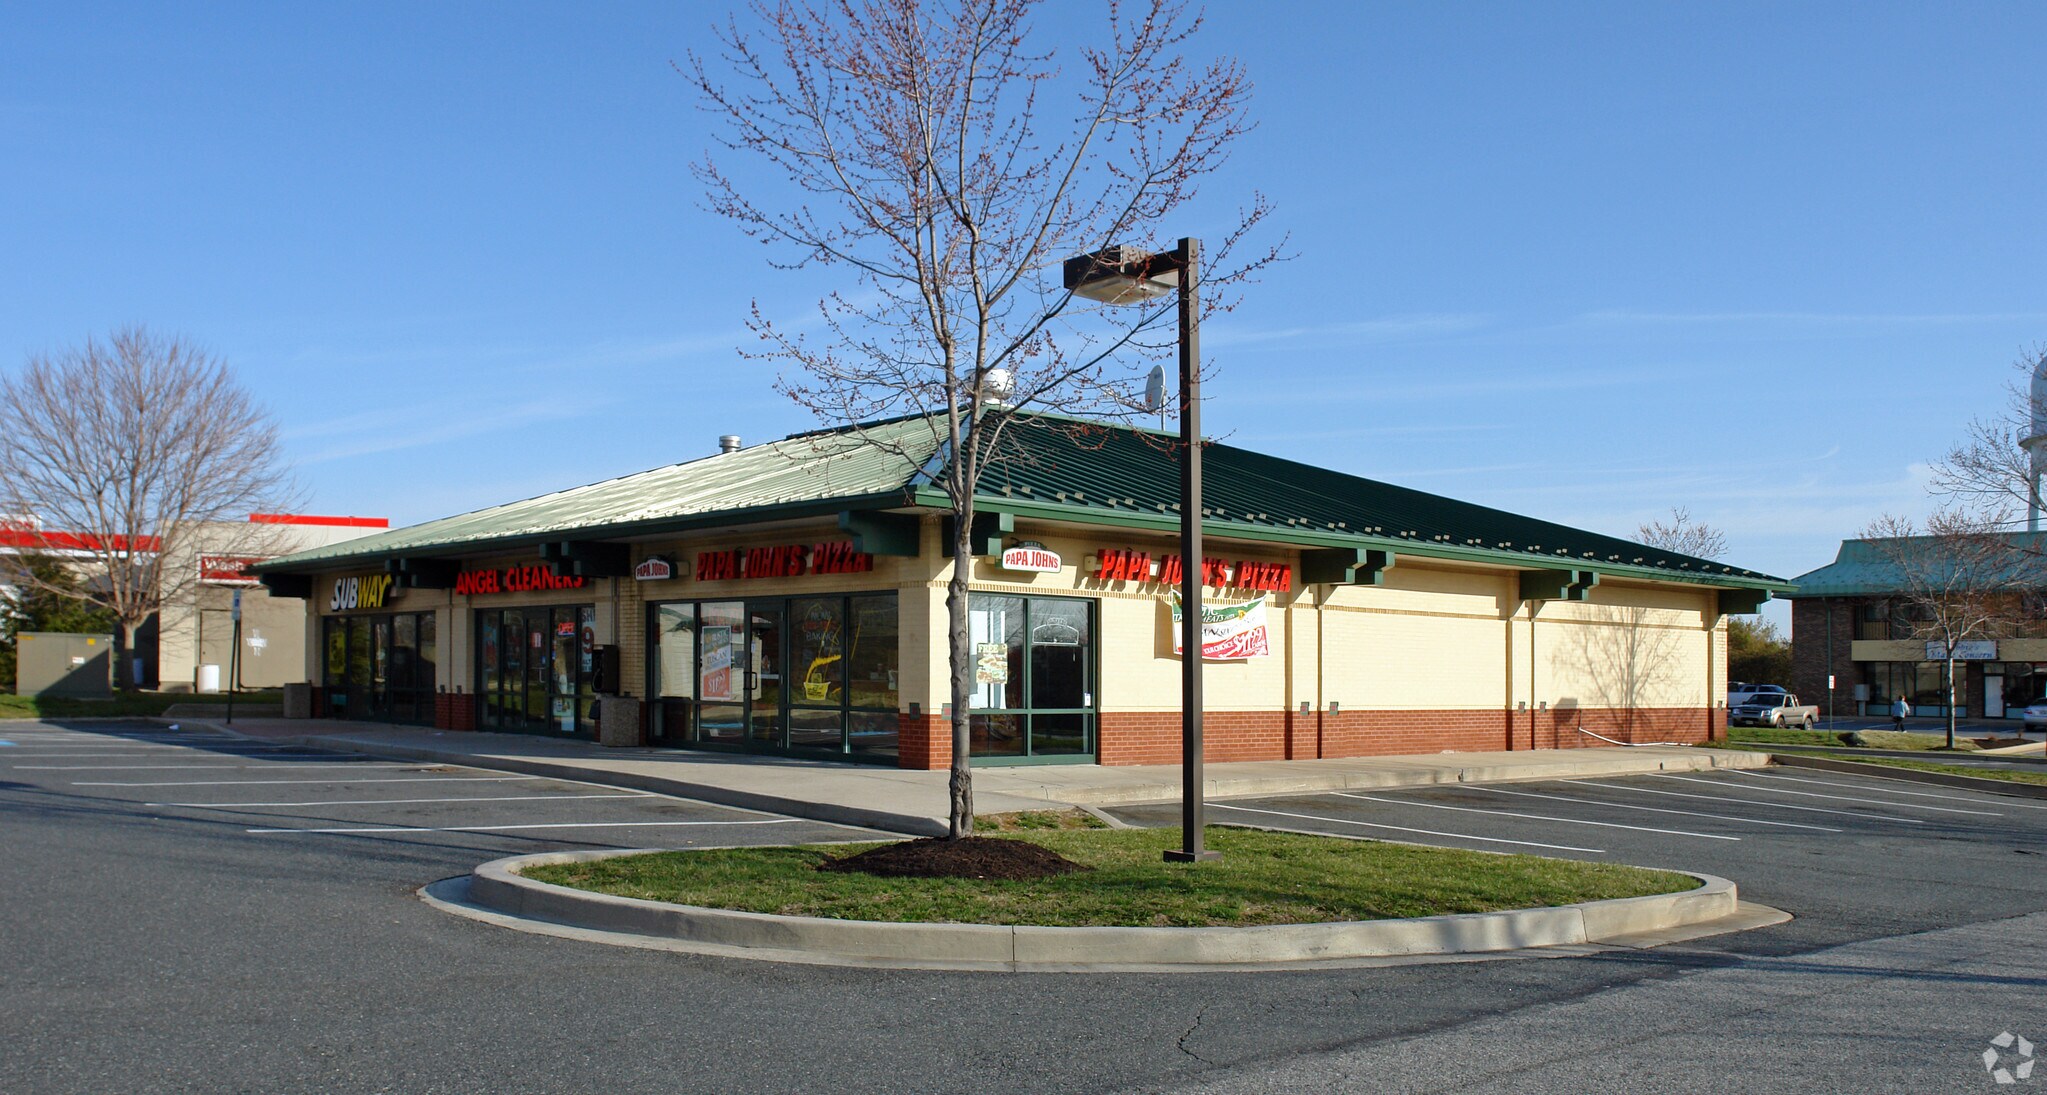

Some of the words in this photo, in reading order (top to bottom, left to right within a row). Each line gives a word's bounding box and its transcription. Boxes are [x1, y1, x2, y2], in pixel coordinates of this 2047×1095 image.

[637, 563, 650, 577] PAPA
[697, 551, 735, 581] PAPA
[744, 545, 805, 579] JOHN'S
[811, 540, 866, 576] PIZZA
[1006, 551, 1028, 566] PAPA
[1030, 551, 1058, 569] JOHNS
[1099, 549, 1151, 582] PAPA
[1161, 554, 1229, 588] JON'S
[1238, 561, 1291, 592] PIZZA
[330, 574, 392, 610] SUBWAY
[456, 568, 499, 595] ANGEL
